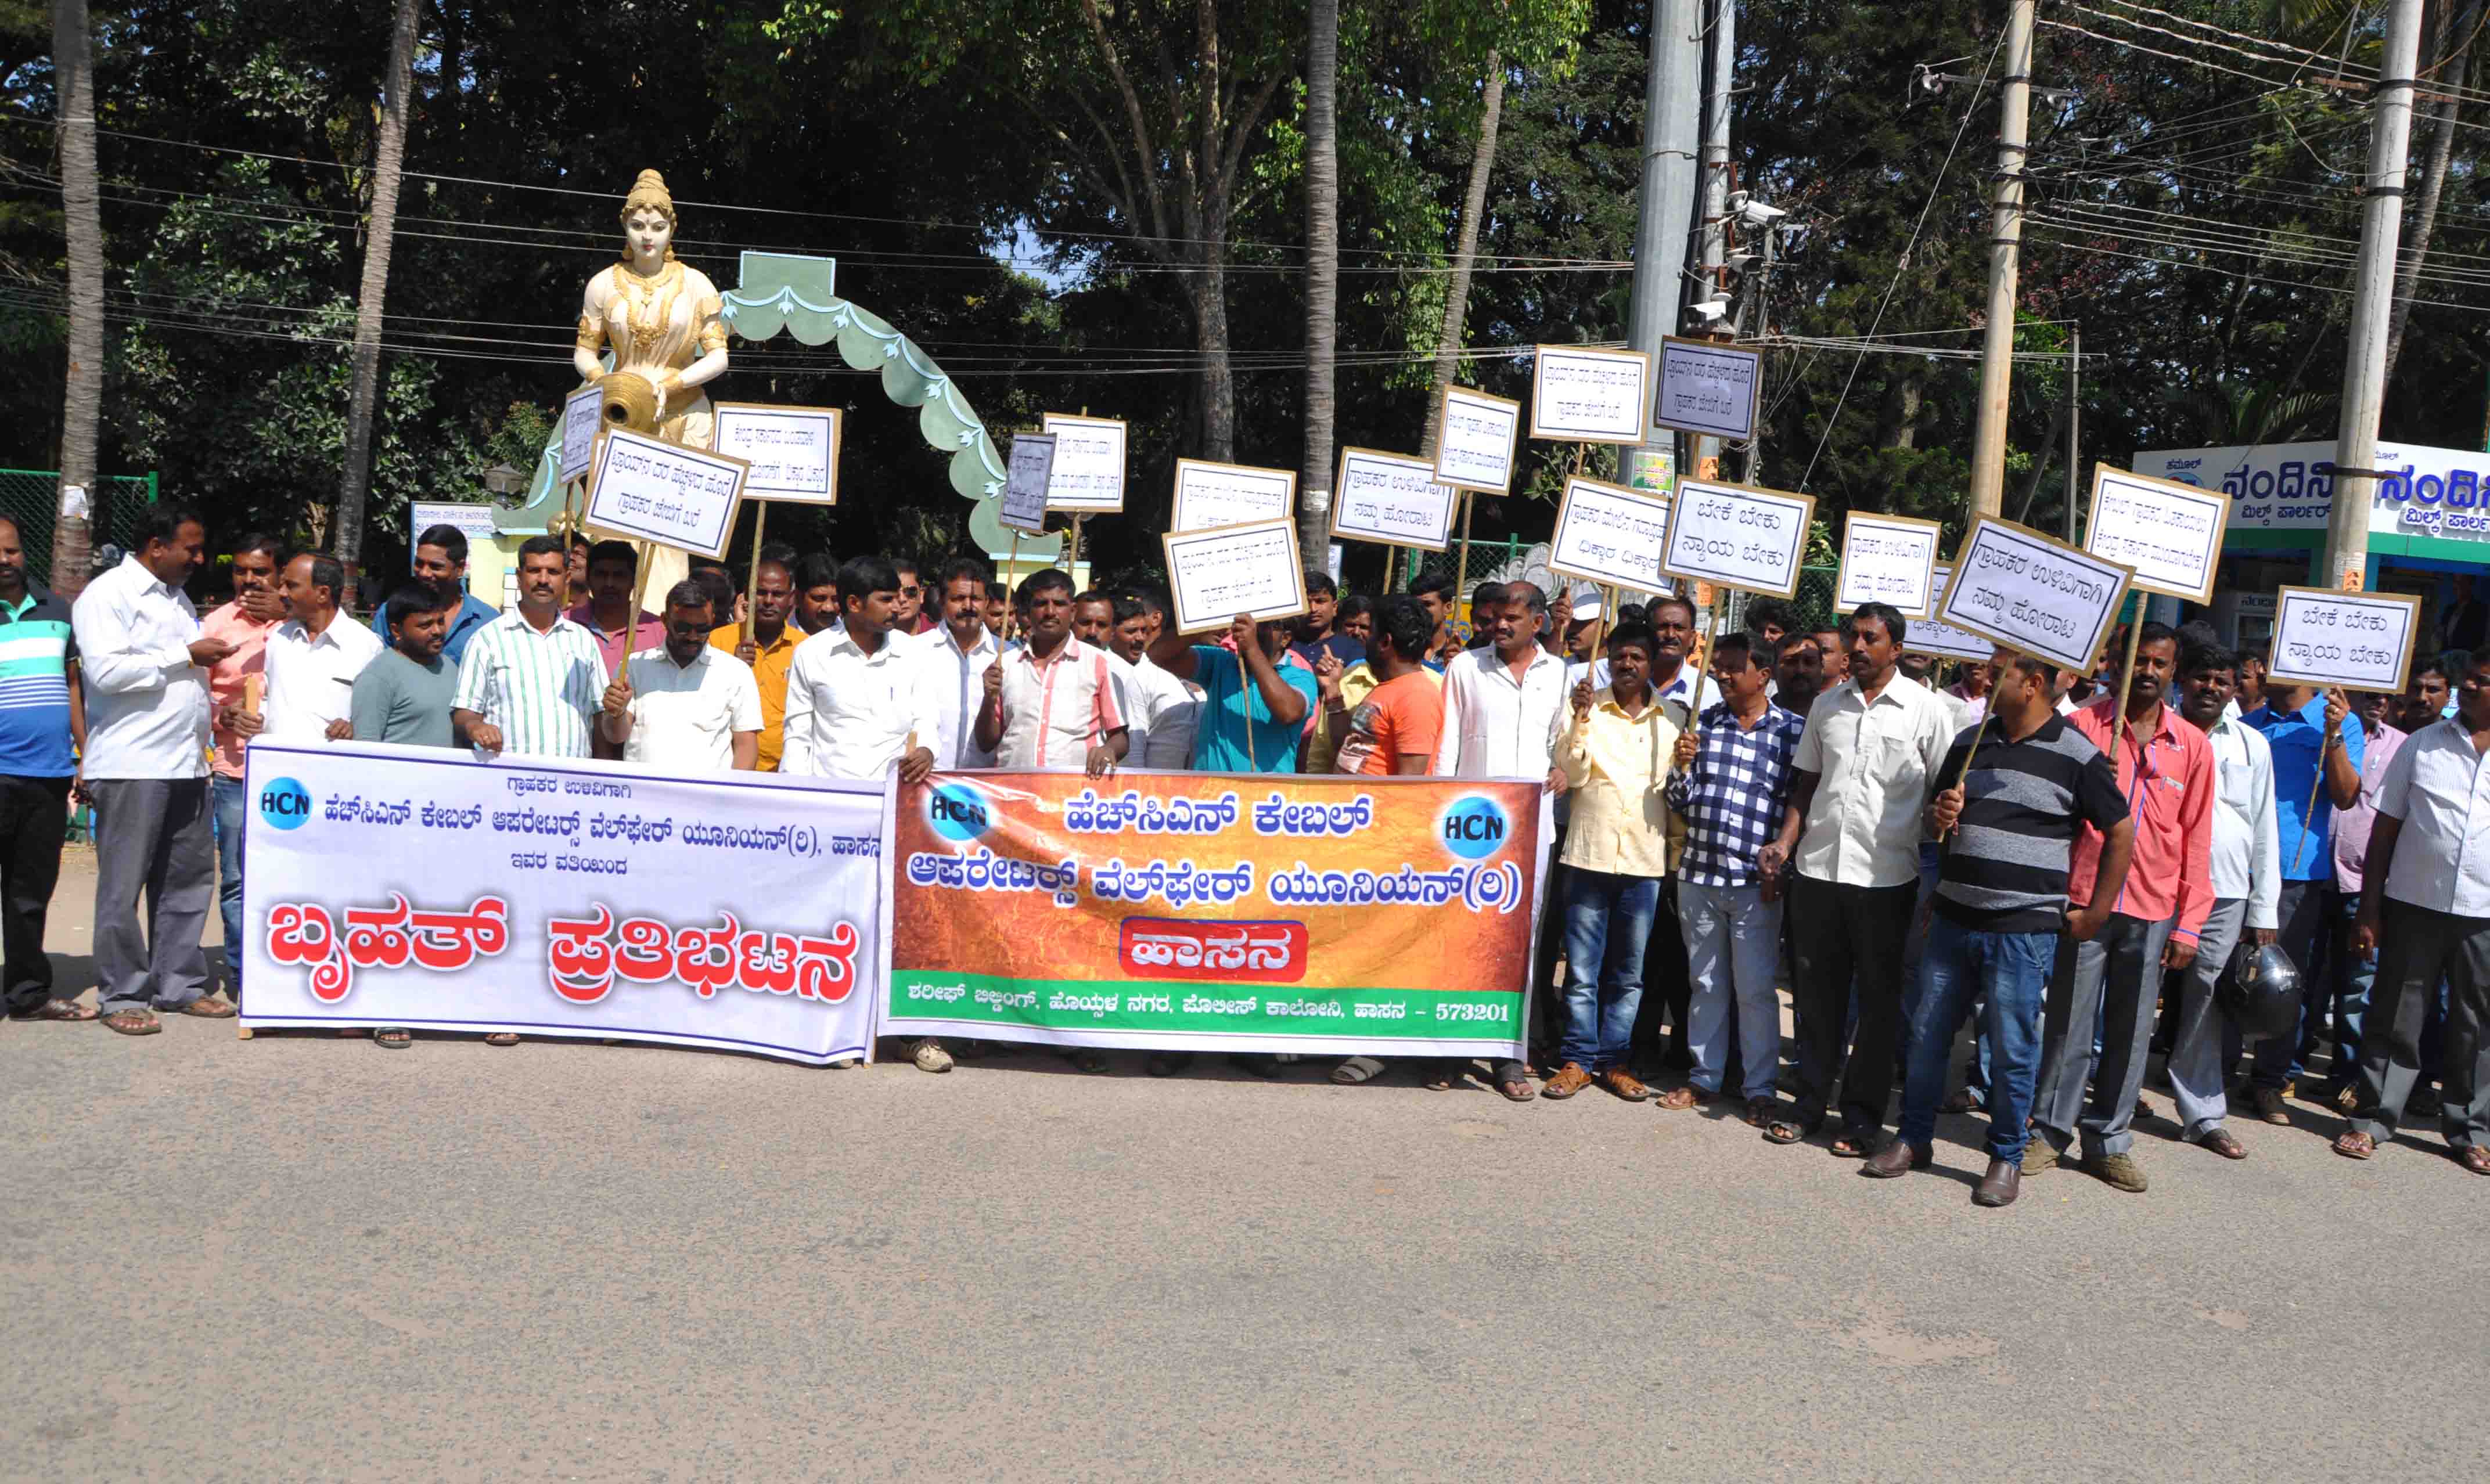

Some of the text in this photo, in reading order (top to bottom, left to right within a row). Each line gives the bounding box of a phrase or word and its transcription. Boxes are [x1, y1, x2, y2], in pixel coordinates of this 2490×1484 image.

[1348, 469, 1388, 488] ಗ್ರಾಹಕರ
[618, 492, 652, 514] ಗ್ರಾಹಕರ
[1354, 503, 1433, 527] ನಮ್ಮ ಹೋರಾಟ
[1697, 499, 1780, 530] ಬೇಕೆ ಬೇಕು
[2406, 507, 2441, 533] ಮಿಲ್ಕ್
[1682, 535, 1784, 567] ನ್ಯಾಯ ಬೇಕು
[1974, 543, 2102, 604] ಗ್ರಾಹಕರ ಉಳಿವಿಗಾಗಿ
[1971, 587, 2005, 624] ನಮ್ಮ
[2010, 599, 2077, 638] ಹೋರಾಟ
[2302, 606, 2388, 632] ಬೇಕೆ ಬೇಕು
[2288, 642, 2391, 667] ನ್ಯಾಯ ಬೇಕು
[507, 775, 632, 799] ಗ್ರಾಹಕರ ಉಳಿವಿಗಾಗಿ
[261, 791, 310, 816] HCN
[421, 800, 482, 830] ಕೇಬಲ್
[931, 794, 988, 826] HCN
[1255, 795, 1370, 833] ಕೇಬಲ್
[1445, 814, 1503, 841] HCN
[510, 851, 628, 876] ಇವರ ವತಿಯಿಂದ
[268, 890, 859, 1003] ಬೃಹತ್ ಪ್ರತಿಭಟನೆ
[1131, 928, 1292, 970] ಹಾಸನ
[908, 982, 966, 1004] ಶರೀಫ್
[1049, 991, 1119, 1017] ಹೊಯ್ಸಳ
[1127, 993, 1174, 1014] ನಗರ,
[1354, 1000, 1406, 1018] ಹಾಸನ
[1435, 1002, 1509, 1022] 573201
